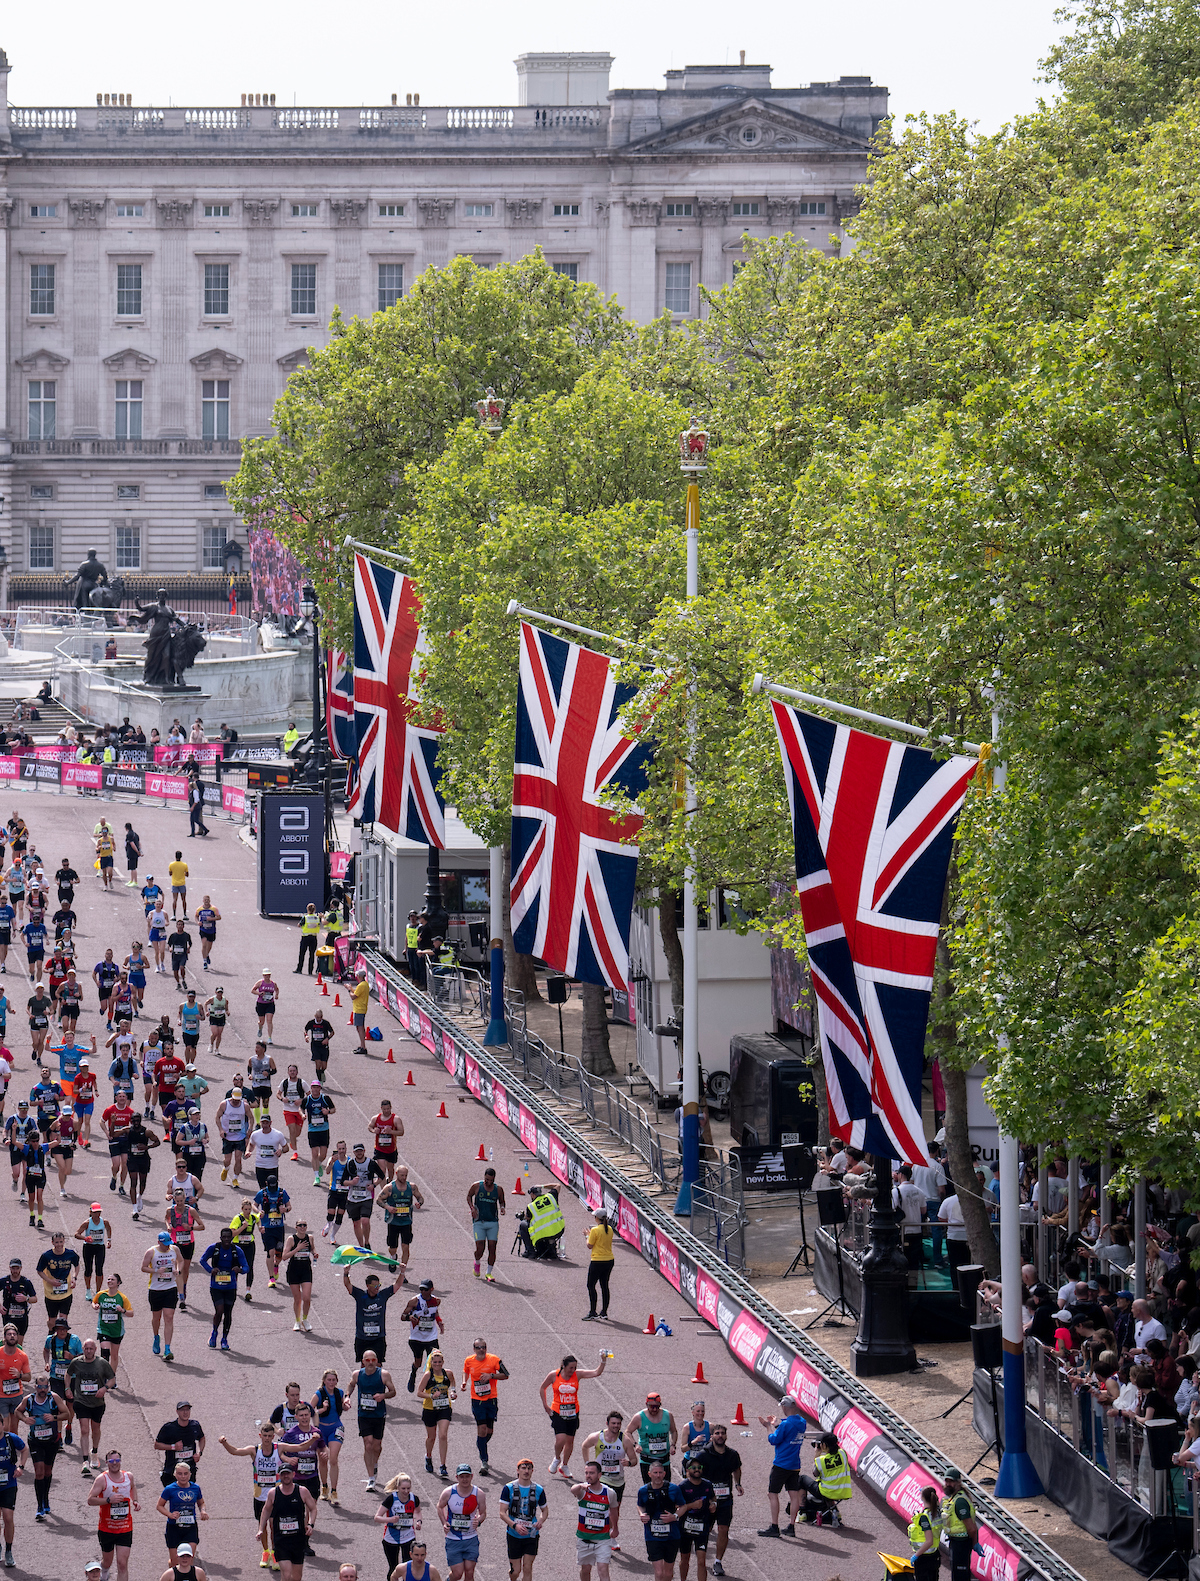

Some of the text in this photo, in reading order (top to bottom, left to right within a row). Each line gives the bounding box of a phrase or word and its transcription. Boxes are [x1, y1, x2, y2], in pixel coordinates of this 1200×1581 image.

[36, 769, 58, 778] MARATHON
[117, 780, 142, 789] MARATHON
[746, 1174, 765, 1184] new
